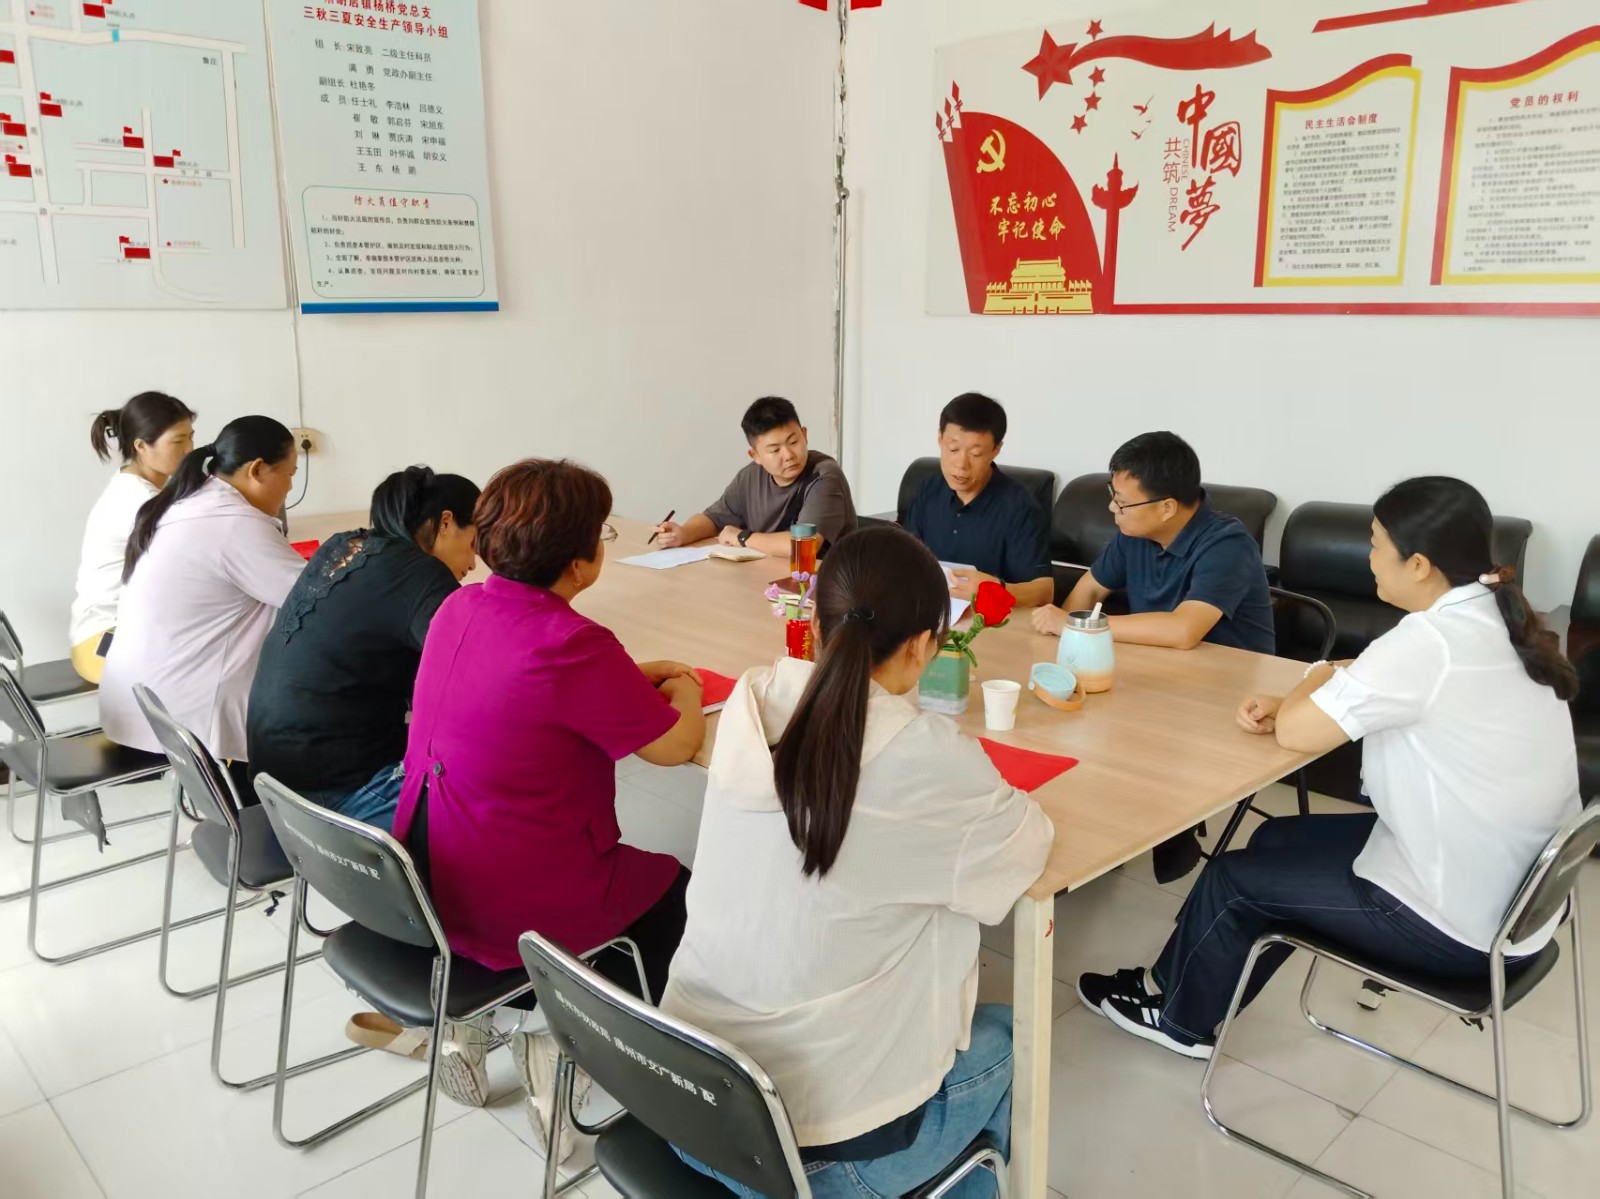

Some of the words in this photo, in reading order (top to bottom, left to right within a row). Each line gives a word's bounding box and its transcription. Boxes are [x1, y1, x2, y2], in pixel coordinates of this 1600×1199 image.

[324, 0, 431, 19] 店镇杨桥党总支
[304, 6, 448, 38] 三秋三夏安全生产领导小组
[382, 48, 432, 63] 二级主任科员
[383, 67, 433, 82] 党政办副主任
[1510, 91, 1579, 109] 党员的权利
[1305, 113, 1378, 130] 民主生活会制度
[1163, 136, 1181, 184] 共筑
[1181, 138, 1190, 179] CHINESE
[989, 191, 1058, 216] 不忘初心
[1167, 187, 1178, 232] DREAM
[997, 215, 1066, 244] 牢记使命
[698, 1085, 717, 1106] 配
